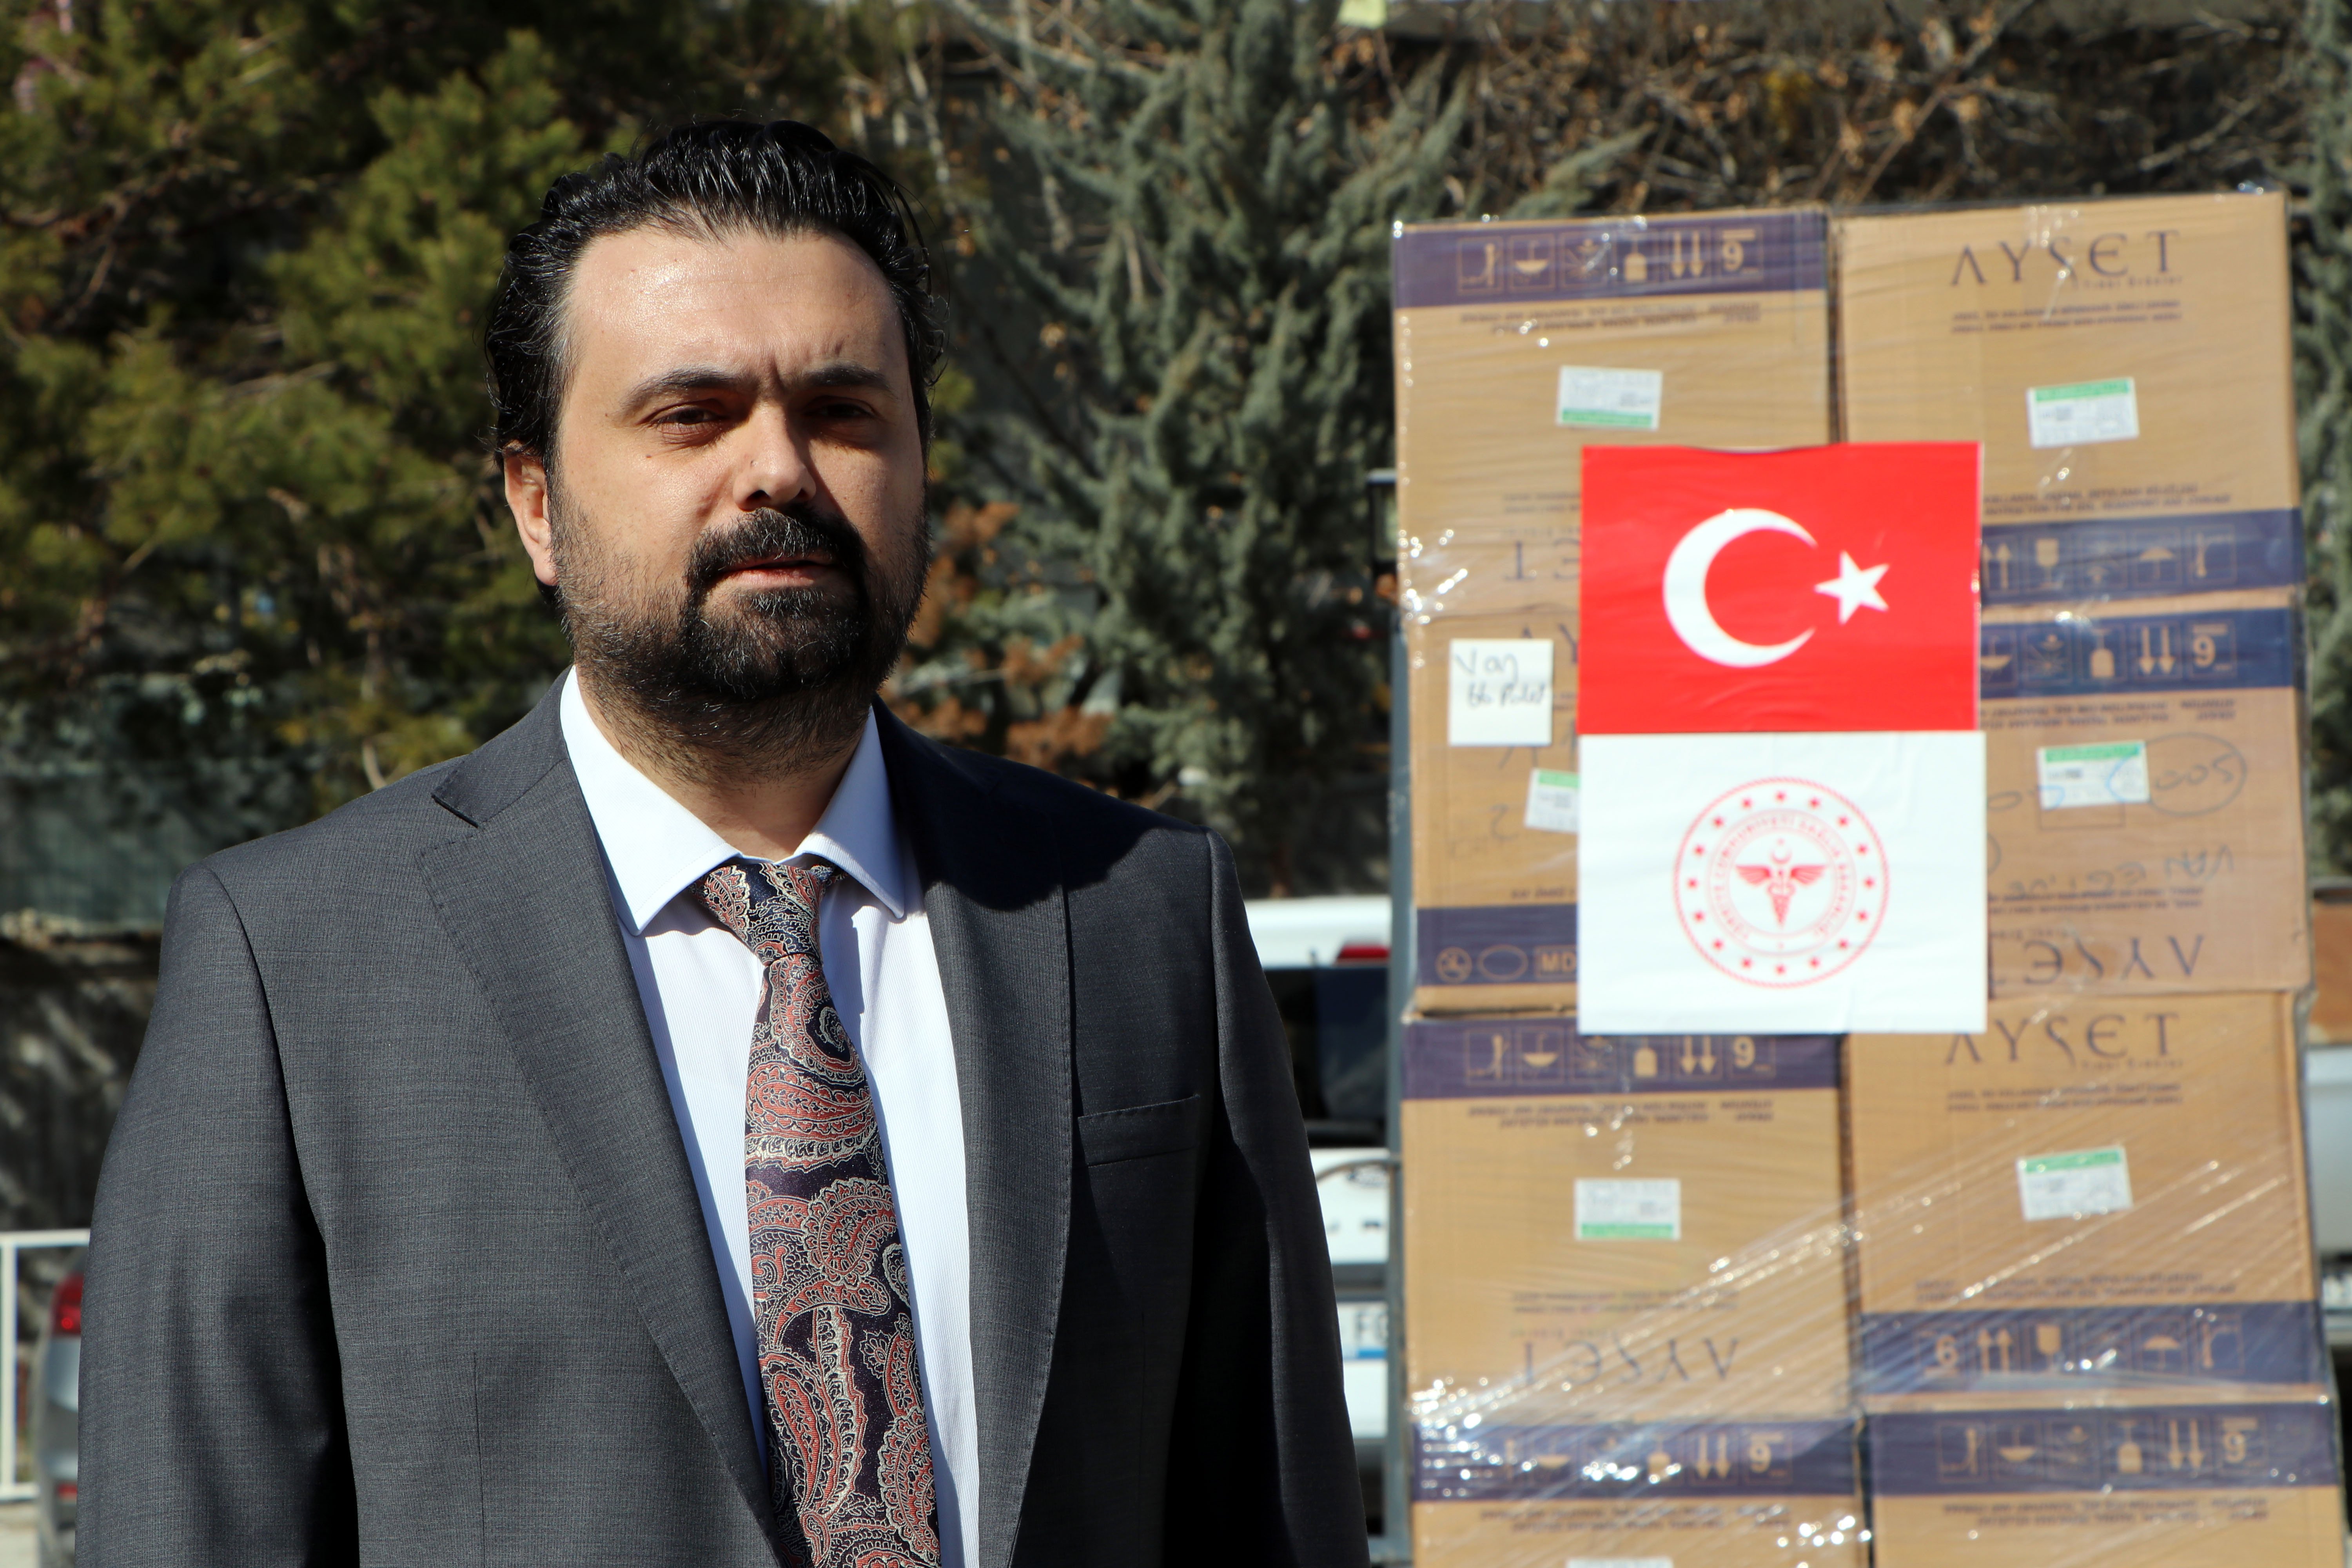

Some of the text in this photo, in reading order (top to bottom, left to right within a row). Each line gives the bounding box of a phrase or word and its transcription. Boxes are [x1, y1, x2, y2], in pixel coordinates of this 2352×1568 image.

[1951, 230, 2180, 289] AYSET
[1991, 933, 2205, 986] AYSE
[1945, 1013, 2180, 1069] AYSET
